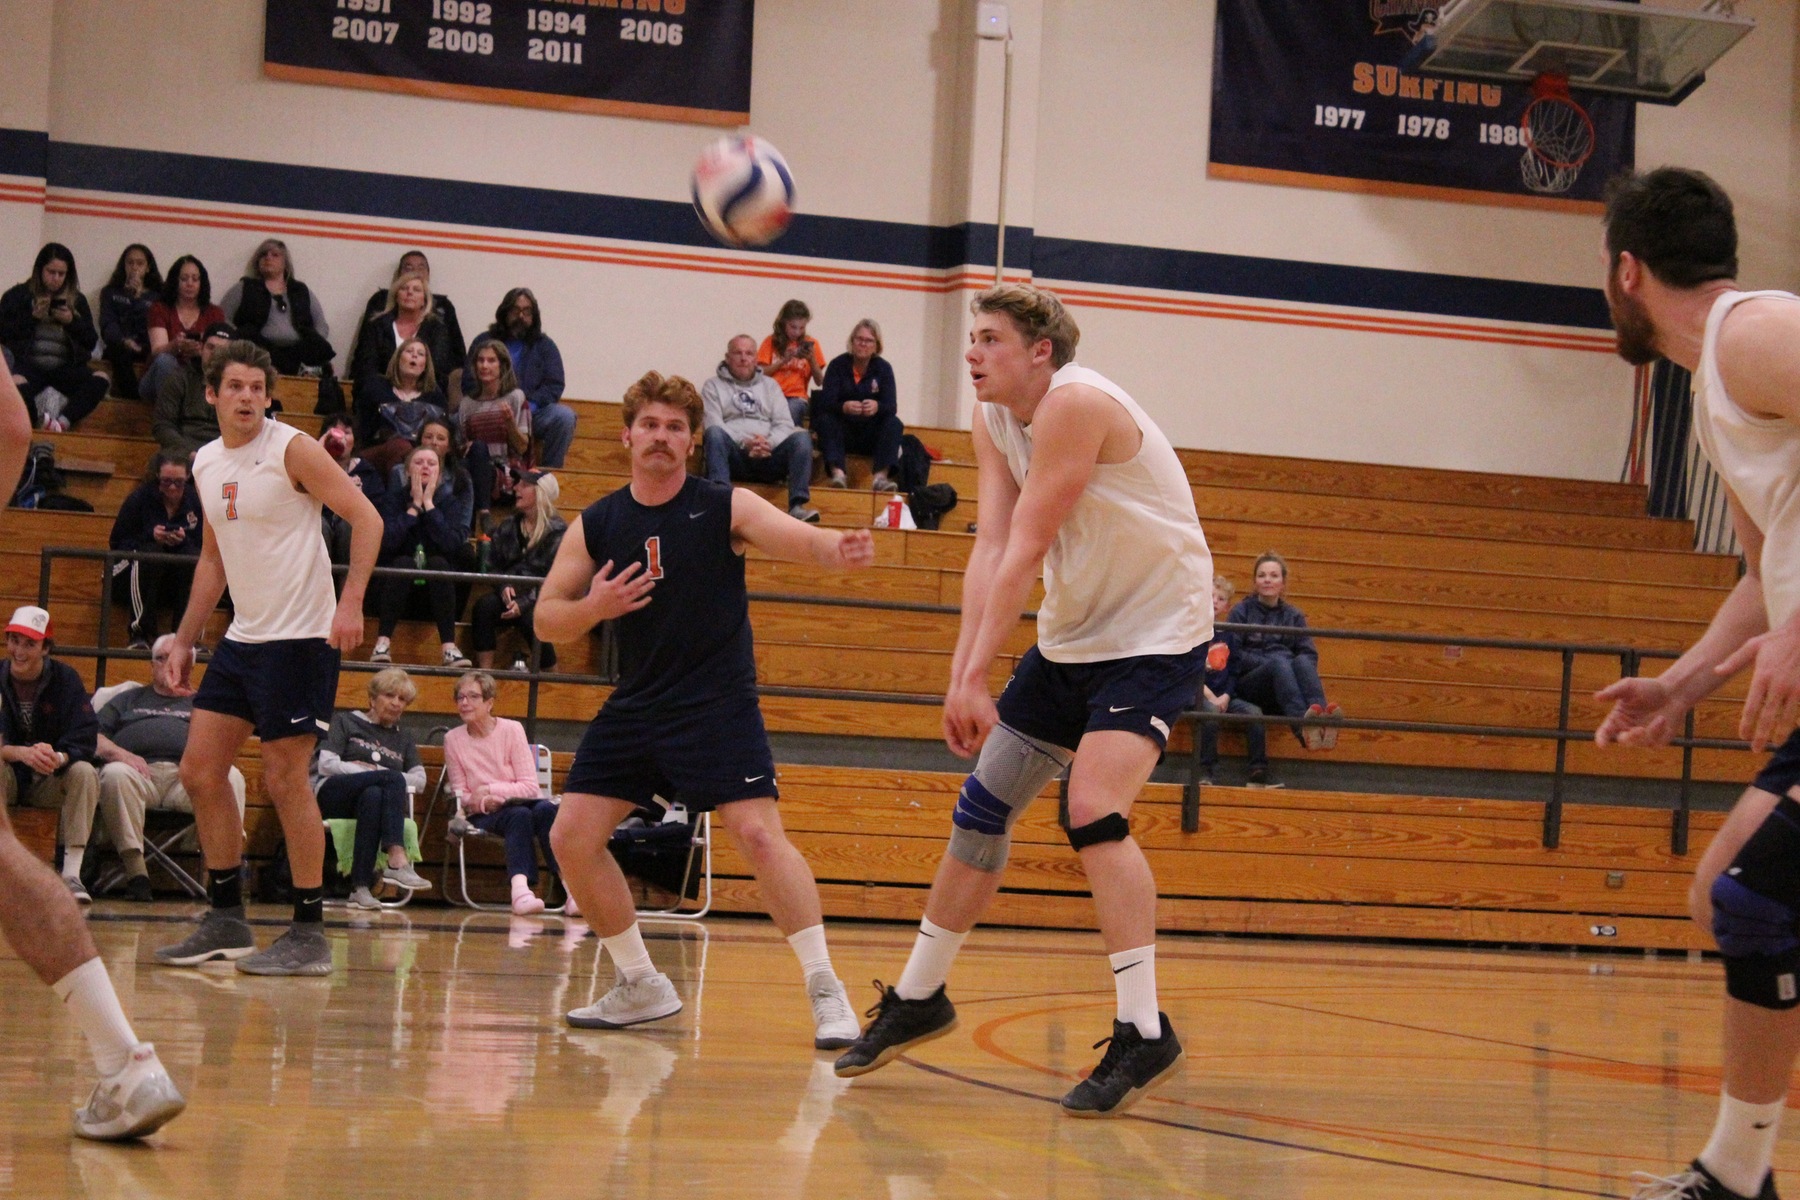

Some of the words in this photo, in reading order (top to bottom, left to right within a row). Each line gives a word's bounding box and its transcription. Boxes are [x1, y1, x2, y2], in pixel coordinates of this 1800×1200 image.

[331, 16, 400, 45] 2007
[427, 27, 494, 55] 2009
[527, 38, 583, 65] 2011
[432, 0, 492, 26] 1992
[527, 9, 587, 36] 1994
[620, 18, 683, 46] 2006
[1352, 62, 1502, 107] SURFING
[1314, 104, 1365, 130] 1977
[1397, 114, 1450, 140] 1978
[221, 481, 239, 521] 7
[643, 535, 664, 581] 1
